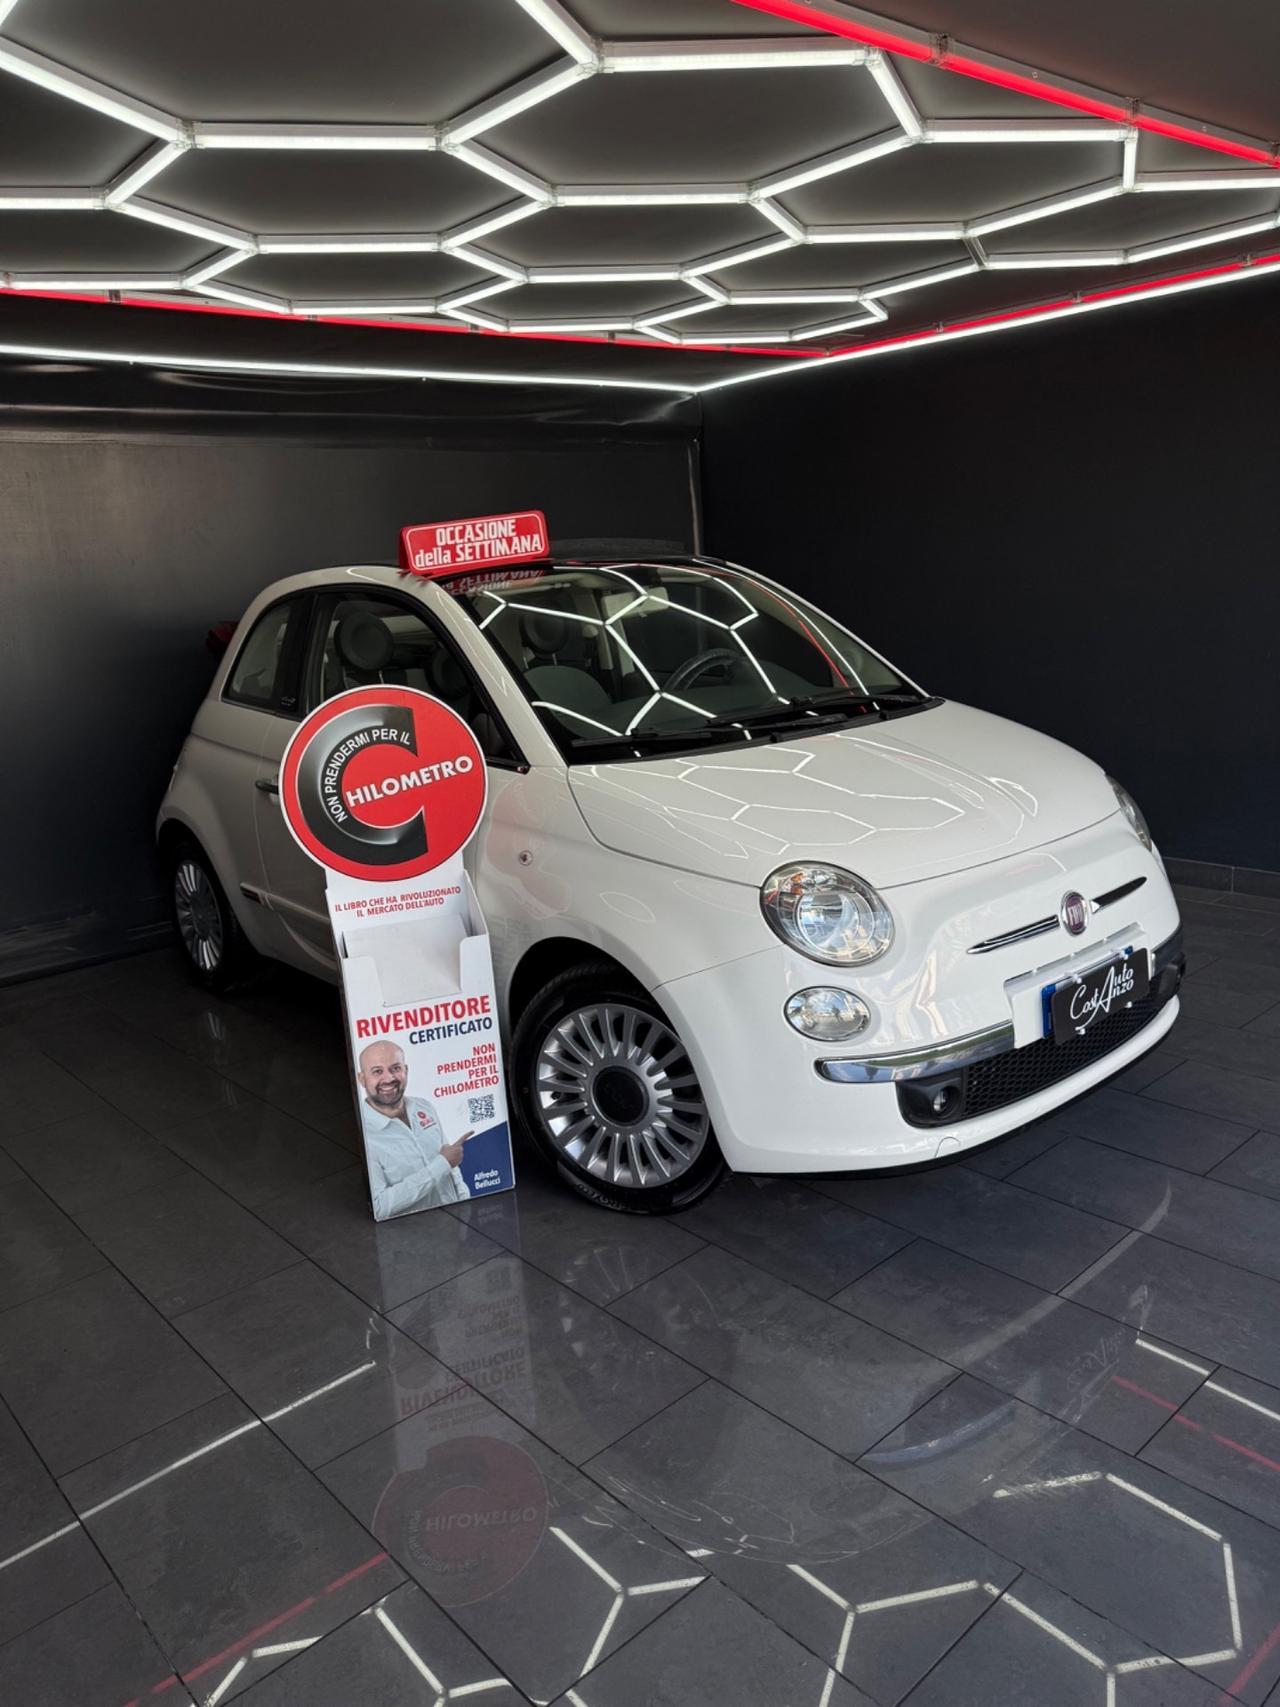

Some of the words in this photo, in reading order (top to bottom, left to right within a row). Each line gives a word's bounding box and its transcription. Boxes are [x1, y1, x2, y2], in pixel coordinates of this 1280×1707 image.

[436, 518, 516, 547] OCCASIONE
[415, 547, 451, 568] della
[455, 533, 542, 562] SETTIMANA
[372, 728, 398, 741] PER
[400, 731, 411, 746] IL
[325, 732, 370, 794] PRENDERMI
[345, 755, 474, 808] HILOMETRO
[327, 793, 348, 823] NON
[335, 904, 343, 912] IL
[344, 899, 367, 912] LIBRO
[369, 897, 385, 907] CHE
[386, 896, 398, 905] HA
[400, 886, 462, 902] RIVOLUZIONATO
[357, 909, 365, 918] IL
[367, 903, 404, 917] MERCATO
[405, 897, 445, 911] DELL'AUTO
[356, 995, 491, 1039] RIVENDITORE
[409, 1017, 493, 1045] CERTIFICATO
[472, 1043, 496, 1056] NON
[437, 1055, 497, 1075] PRENDERMI
[469, 1068, 489, 1079] PER
[489, 1066, 499, 1075] IL
[434, 1075, 499, 1098] CHILOMETRO
[474, 1169, 499, 1181] Alfredo
